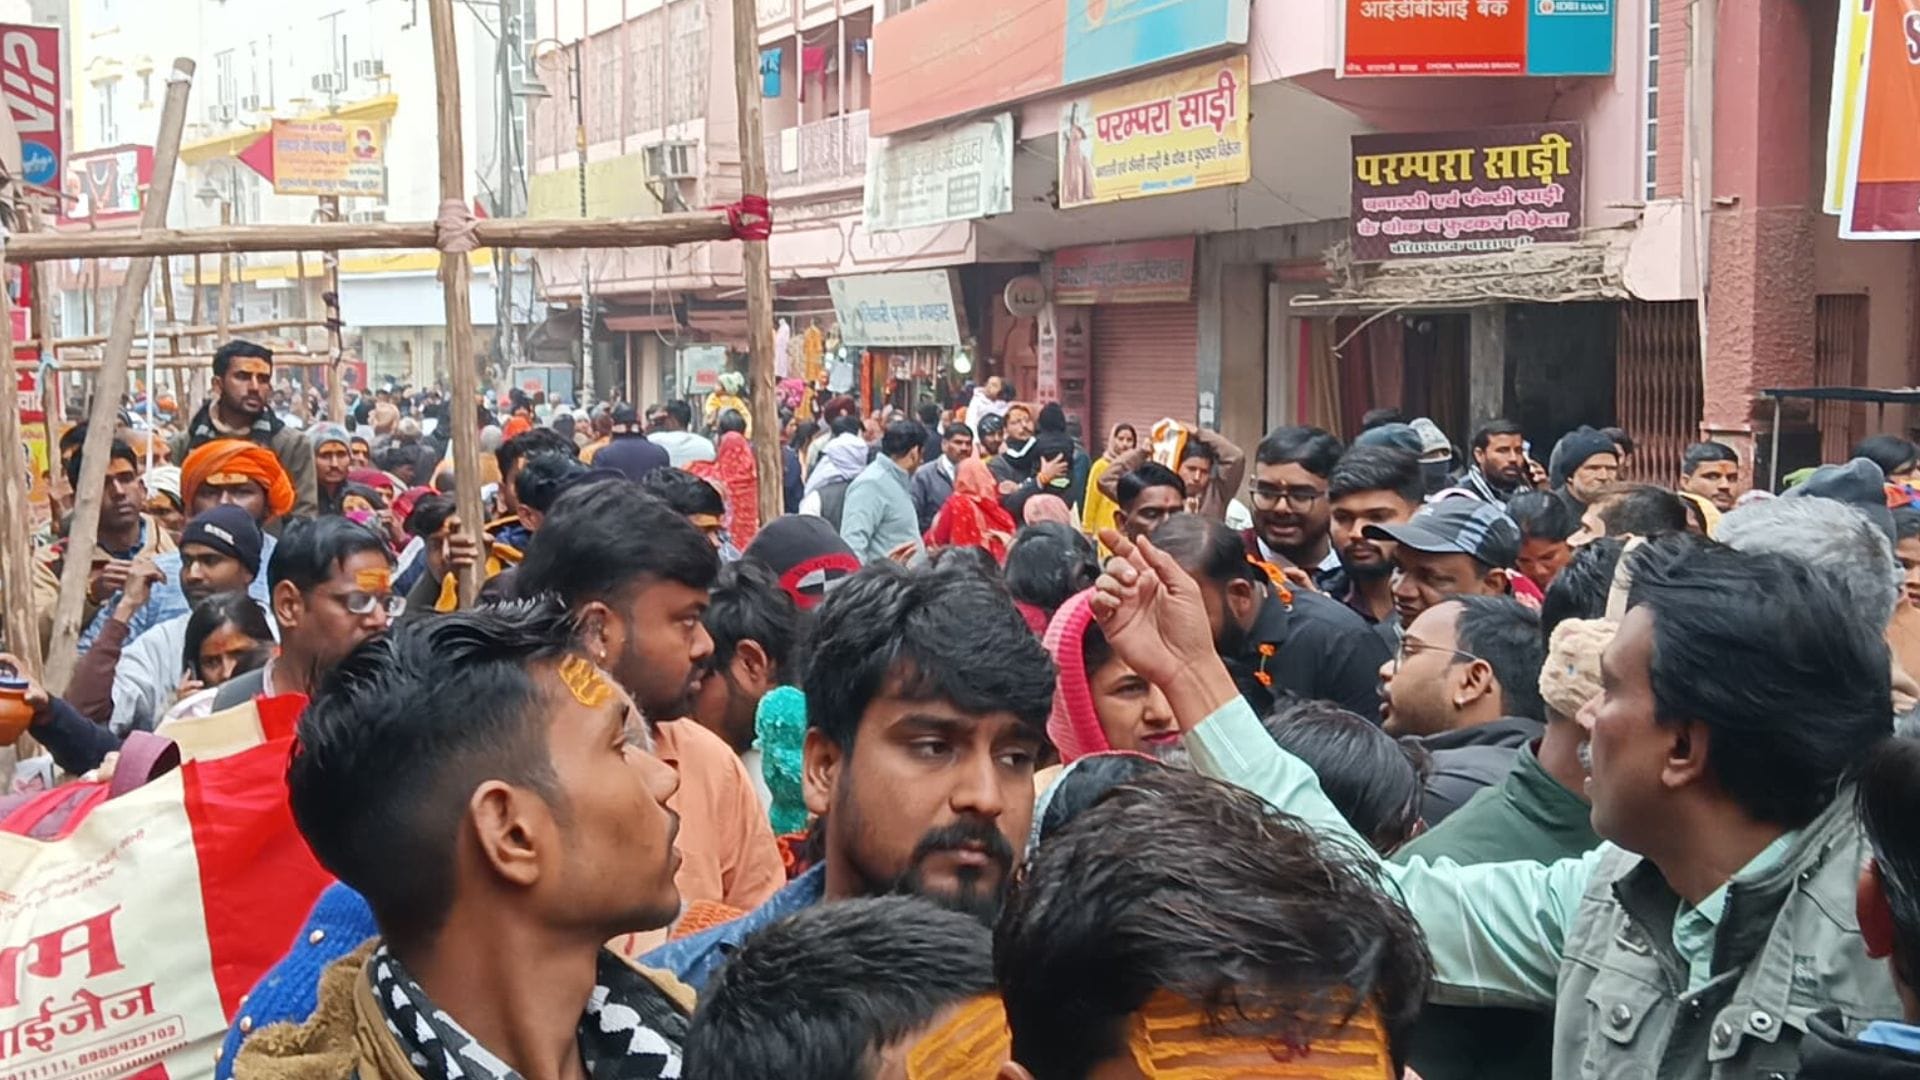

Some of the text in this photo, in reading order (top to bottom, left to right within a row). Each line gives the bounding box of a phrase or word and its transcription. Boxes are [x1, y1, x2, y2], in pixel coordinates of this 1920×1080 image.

[3, 31, 55, 133] VIP
[1096, 70, 1237, 142] परम्परा साड़ी
[1356, 133, 1573, 186] परम्परा साड़ी
[1357, 209, 1571, 239] के थोक व फुटकर विक्रेता
[1432, 189, 1460, 210] एवं
[1517, 184, 1565, 208] साड़ी
[0, 982, 156, 1060] ाईजेज
